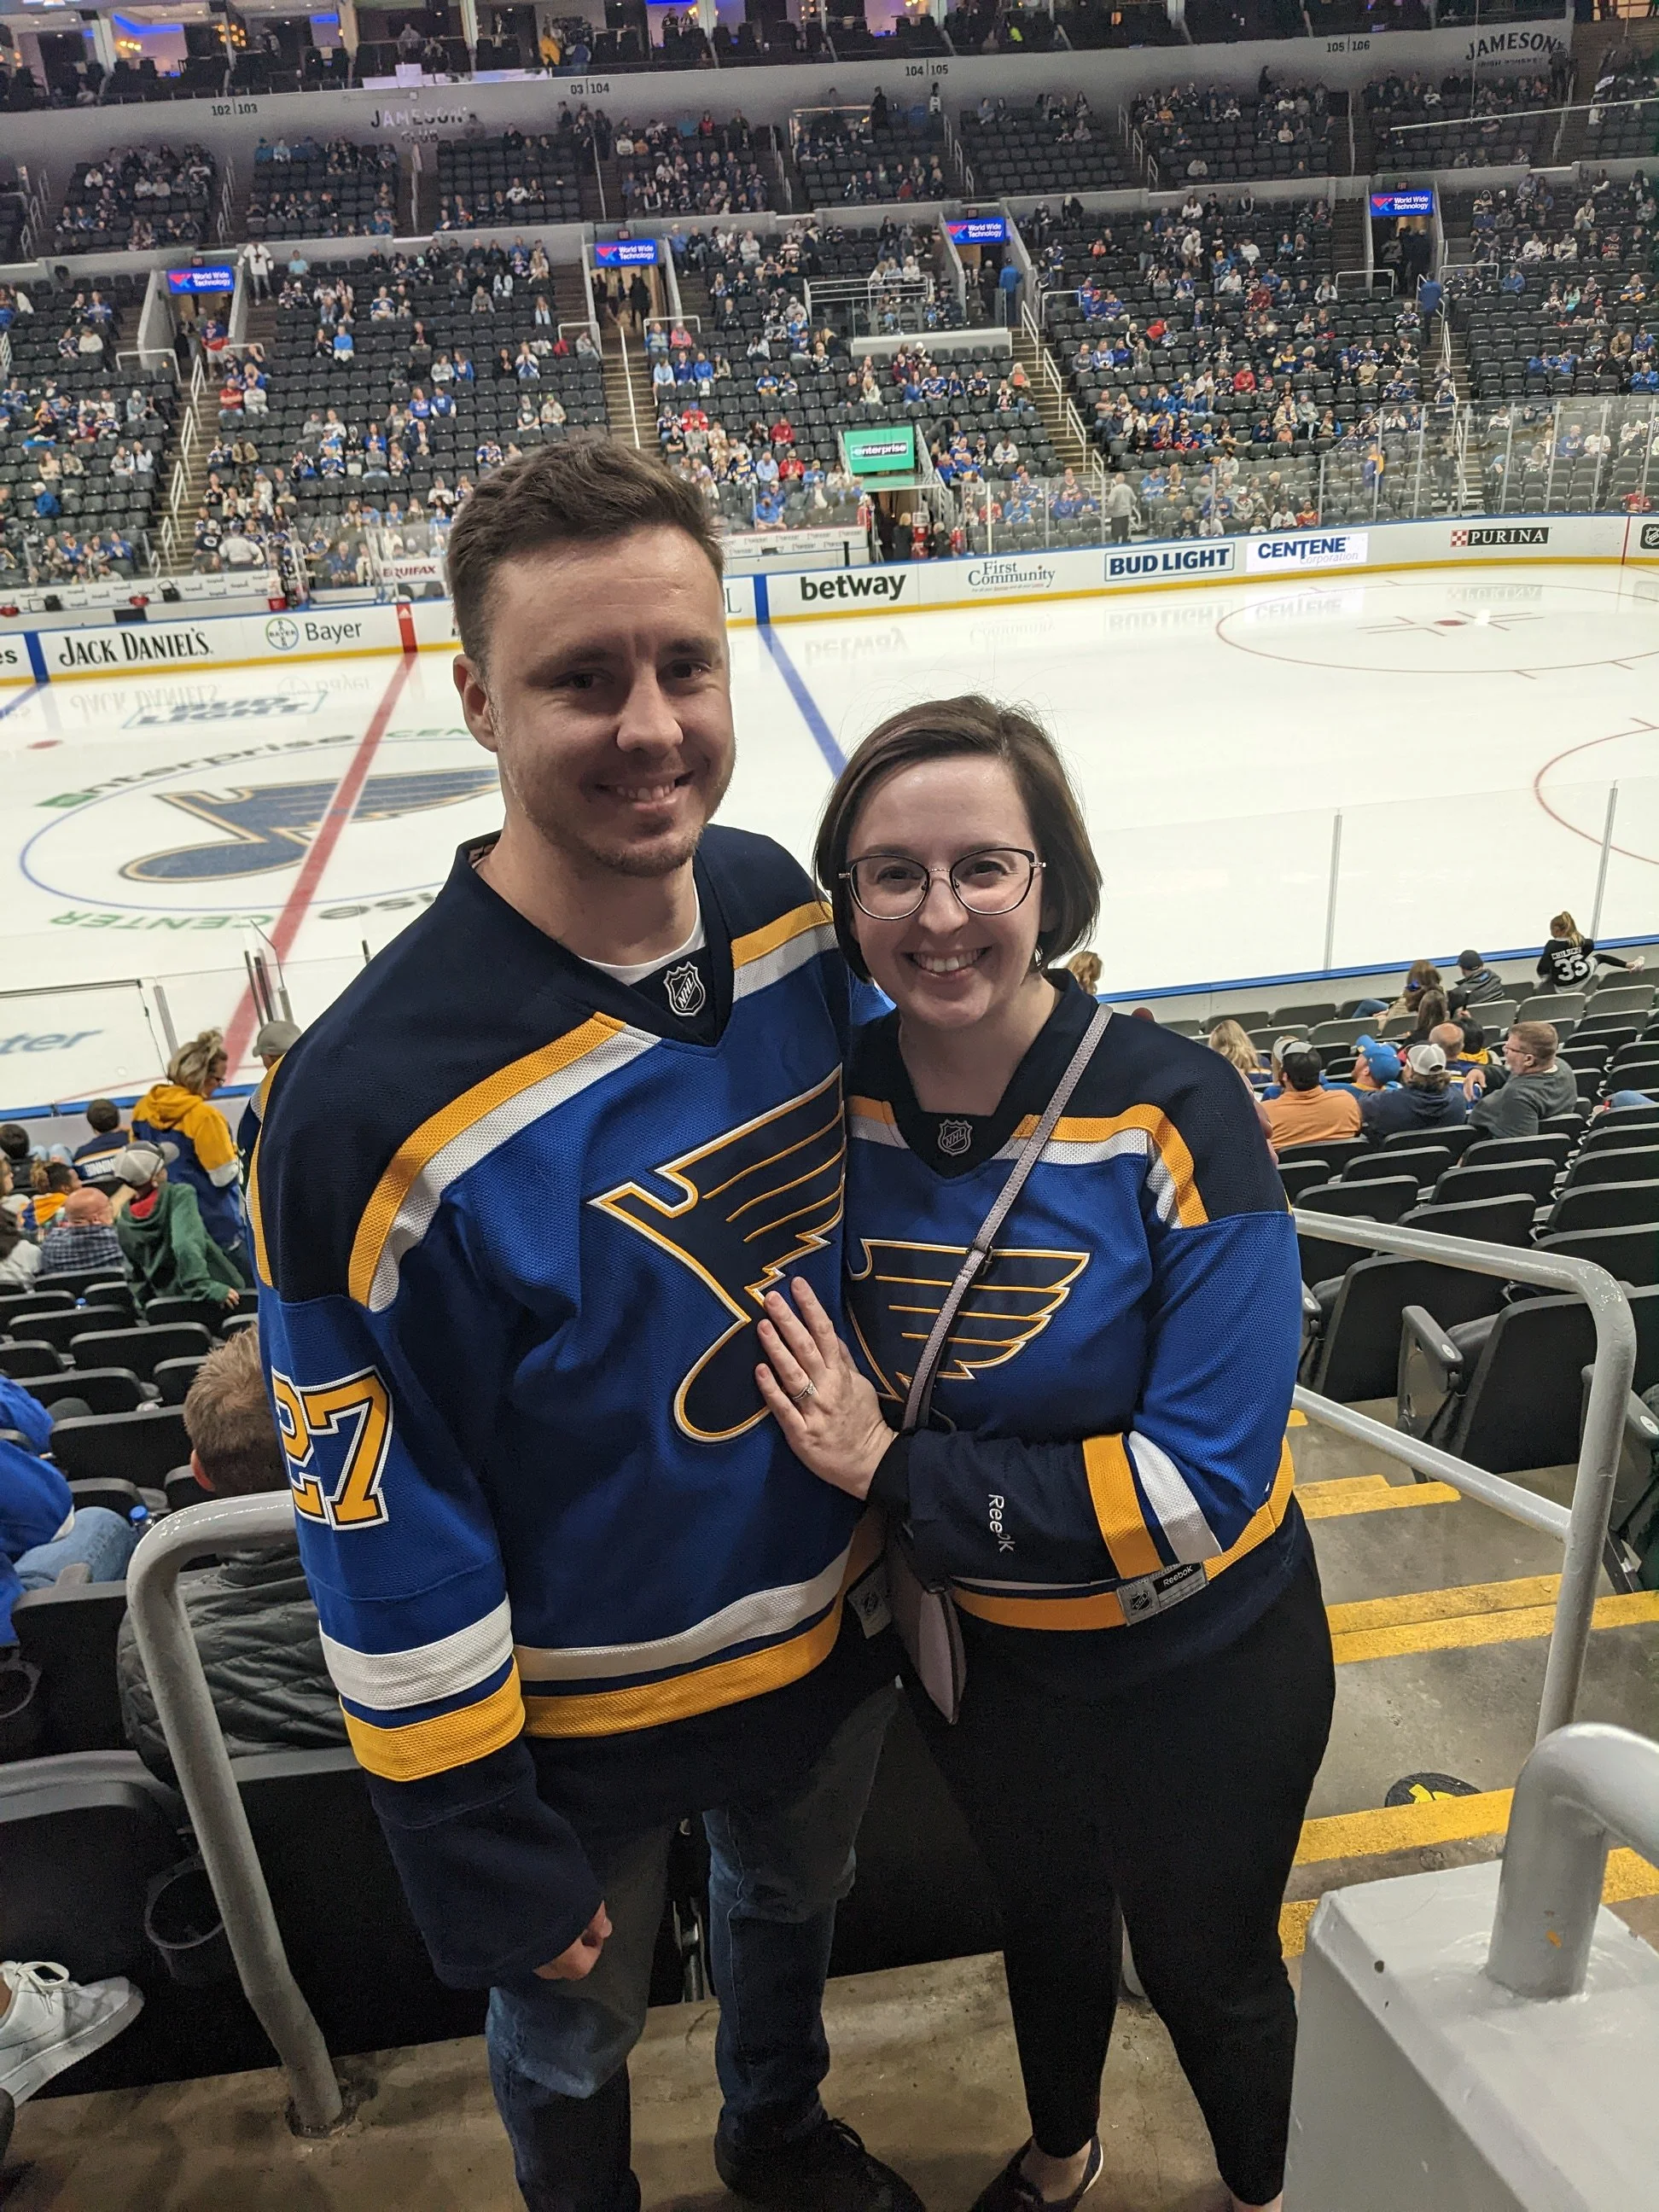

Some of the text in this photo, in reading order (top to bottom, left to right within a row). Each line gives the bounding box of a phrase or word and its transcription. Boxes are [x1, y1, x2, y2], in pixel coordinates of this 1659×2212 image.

[1326, 40, 1371, 53] 105 106
[1464, 32, 1558, 61] JAMESON
[905, 64, 949, 76] 104 105
[591, 82, 610, 94] 104
[212, 102, 258, 116] 102 103
[1393, 202, 1429, 211] Technology
[968, 230, 1003, 238] Technology
[618, 252, 655, 260] Technology
[637, 244, 655, 253] Wide
[194, 278, 230, 287] Technology
[853, 442, 907, 456] enterprise
[1470, 528, 1545, 544] PURINA
[1258, 536, 1348, 559] CENTENE
[1109, 547, 1231, 577] BUD LIGHT
[1300, 550, 1359, 566] Corporation
[382, 564, 436, 579] EQUIFAX
[982, 560, 1017, 576] First
[968, 565, 1056, 588] Community
[800, 573, 907, 602] betway
[305, 621, 363, 644] Bayer
[59, 627, 213, 667] JACK DANIEL'S
[677, 976, 694, 1009] NHL
[944, 1129, 965, 1148] NHL
[271, 1364, 395, 1532] 27
